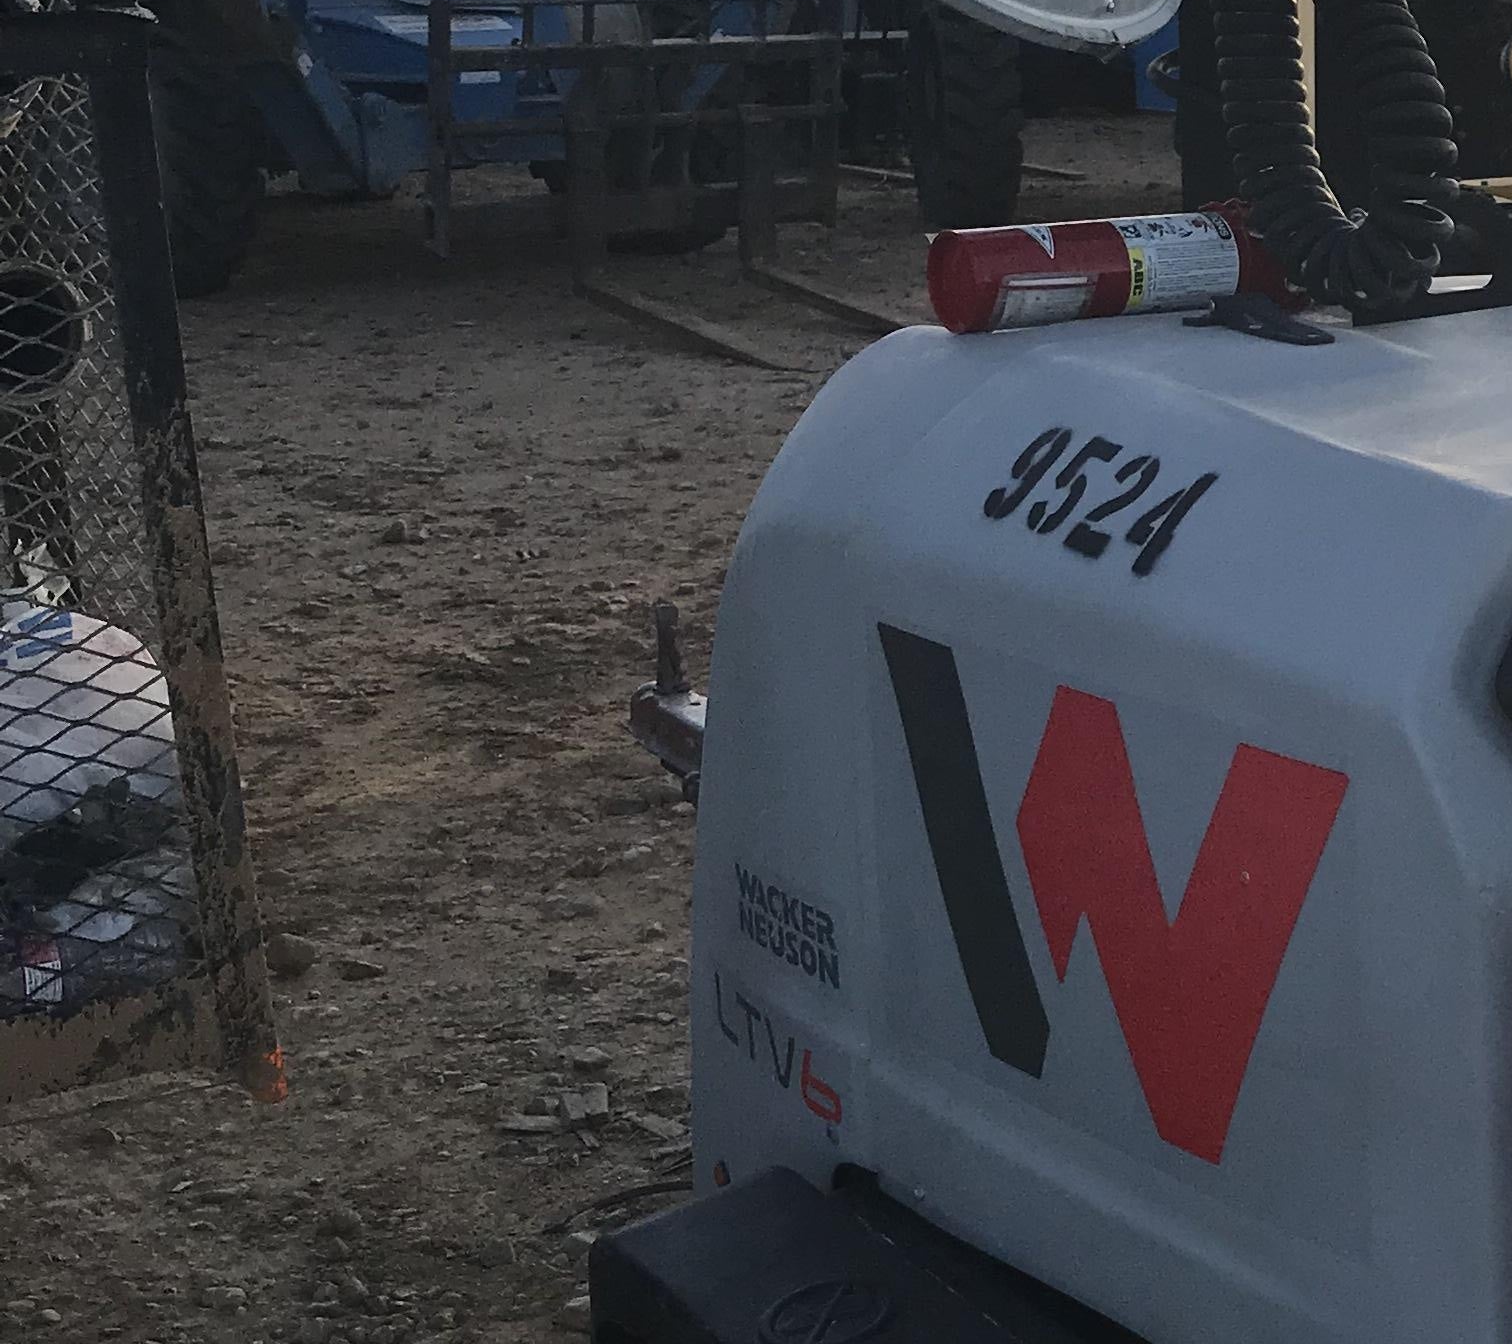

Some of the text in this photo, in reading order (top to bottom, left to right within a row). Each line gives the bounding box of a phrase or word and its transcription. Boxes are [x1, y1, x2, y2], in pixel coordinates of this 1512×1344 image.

[1132, 258, 1144, 297] ABC
[983, 426, 1221, 576] 9524
[734, 862, 837, 951] WACKER
[738, 901, 841, 990] NEUSON
